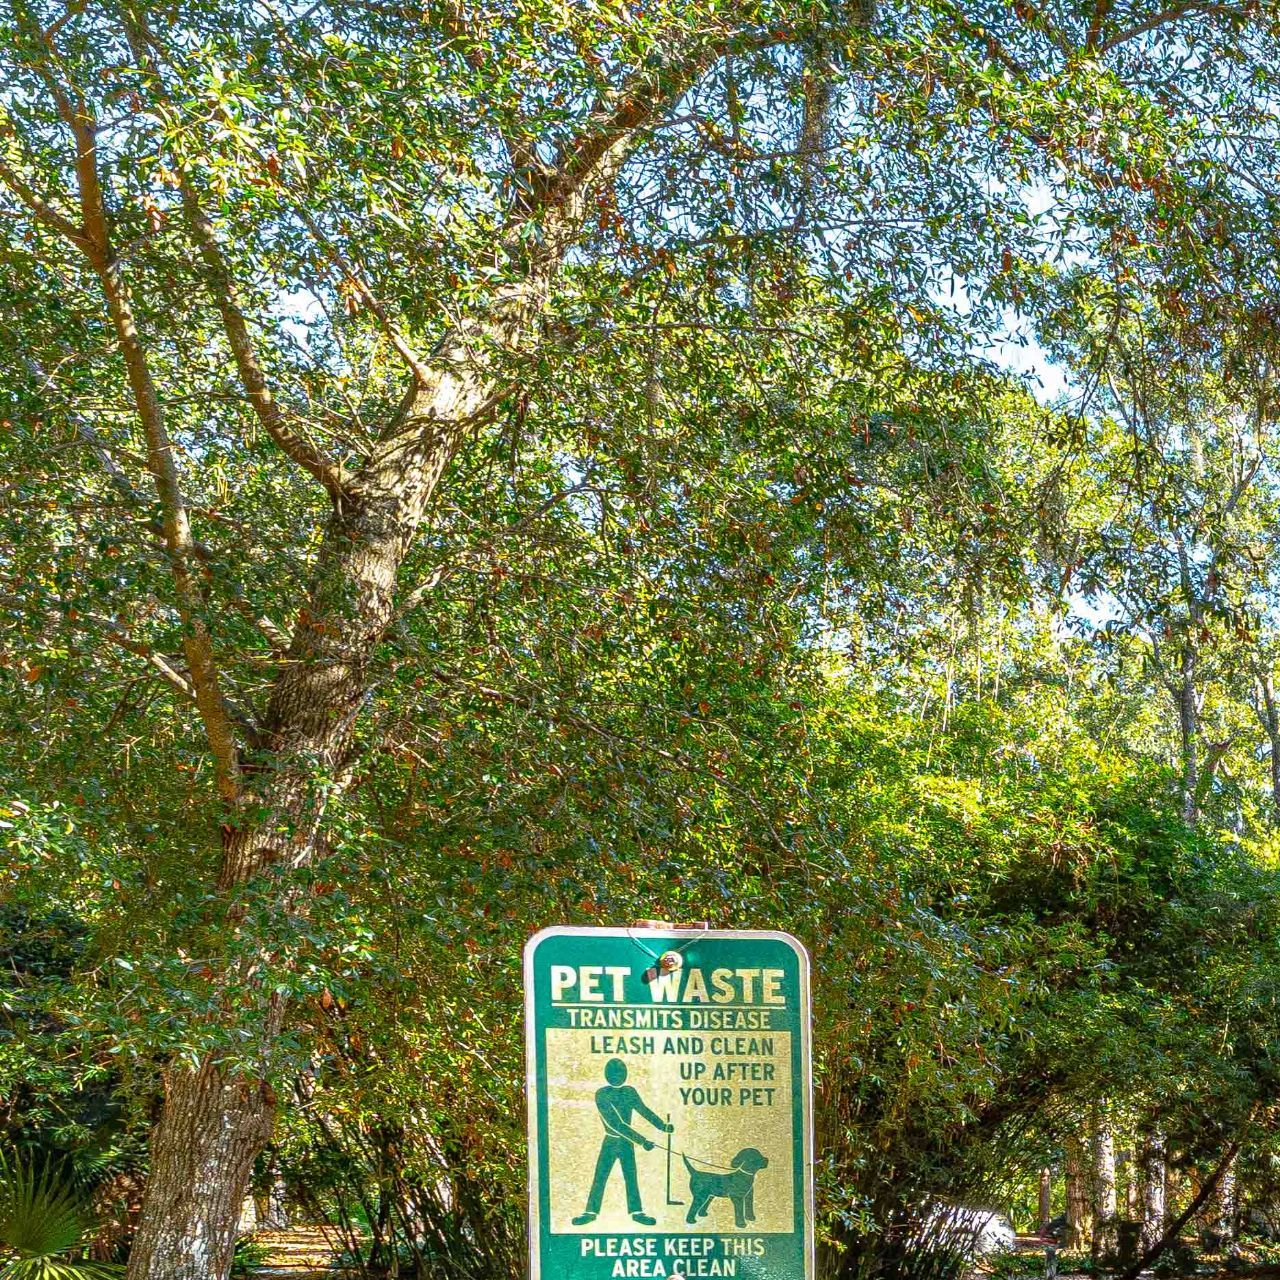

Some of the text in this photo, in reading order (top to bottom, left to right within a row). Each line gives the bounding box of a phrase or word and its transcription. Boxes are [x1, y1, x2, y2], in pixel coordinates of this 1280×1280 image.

[551, 965, 785, 1004] PET WASTE
[567, 1009, 771, 1029] TRANSMITS DISEASE
[591, 1036, 773, 1056] LEASH AND CLEAN
[680, 1063, 774, 1080] UP AFTER
[679, 1088, 775, 1106] YOUR PET
[581, 1238, 765, 1257] PLEASE KEEP THIS
[612, 1259, 735, 1277] AREA CLEAN
